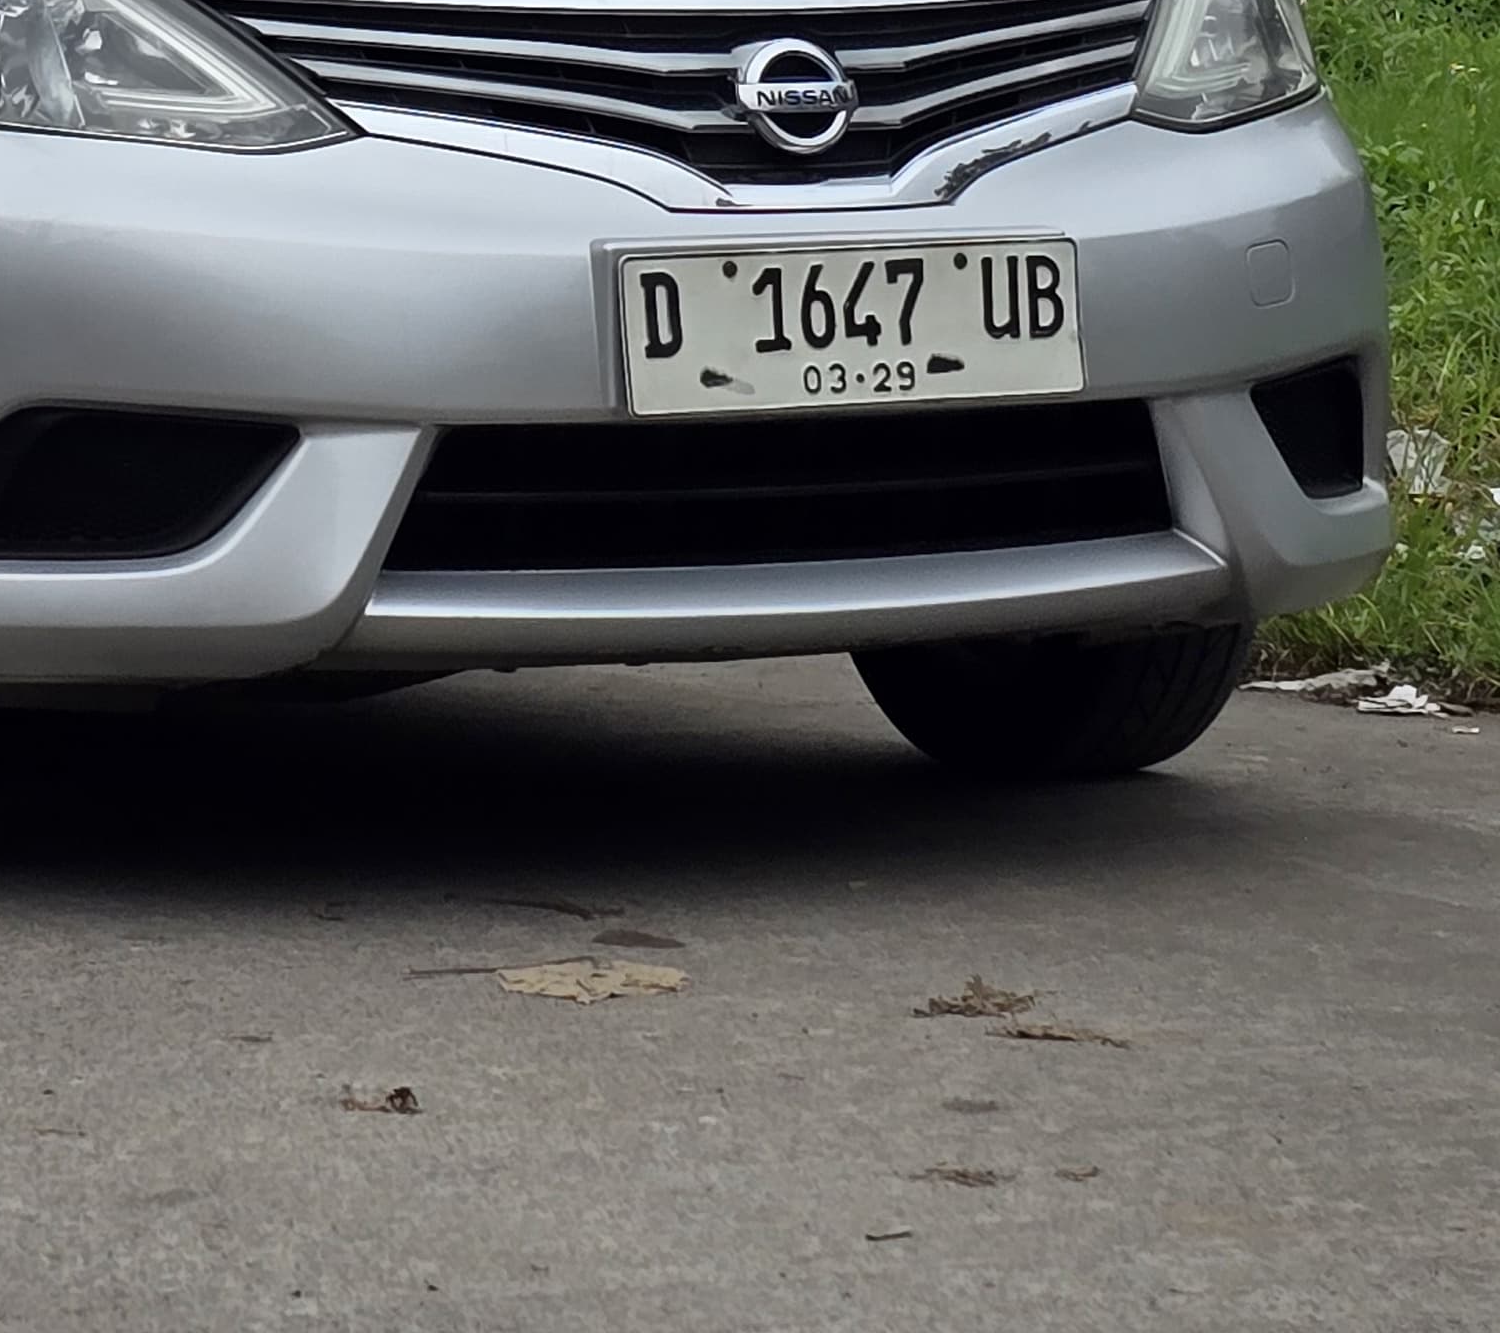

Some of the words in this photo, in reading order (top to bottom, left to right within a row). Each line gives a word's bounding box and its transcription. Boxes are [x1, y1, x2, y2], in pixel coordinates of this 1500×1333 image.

[756, 88, 848, 107] NISSAN
[639, 271, 683, 359] D
[752, 257, 925, 353] 1647
[981, 255, 1065, 339] UB
